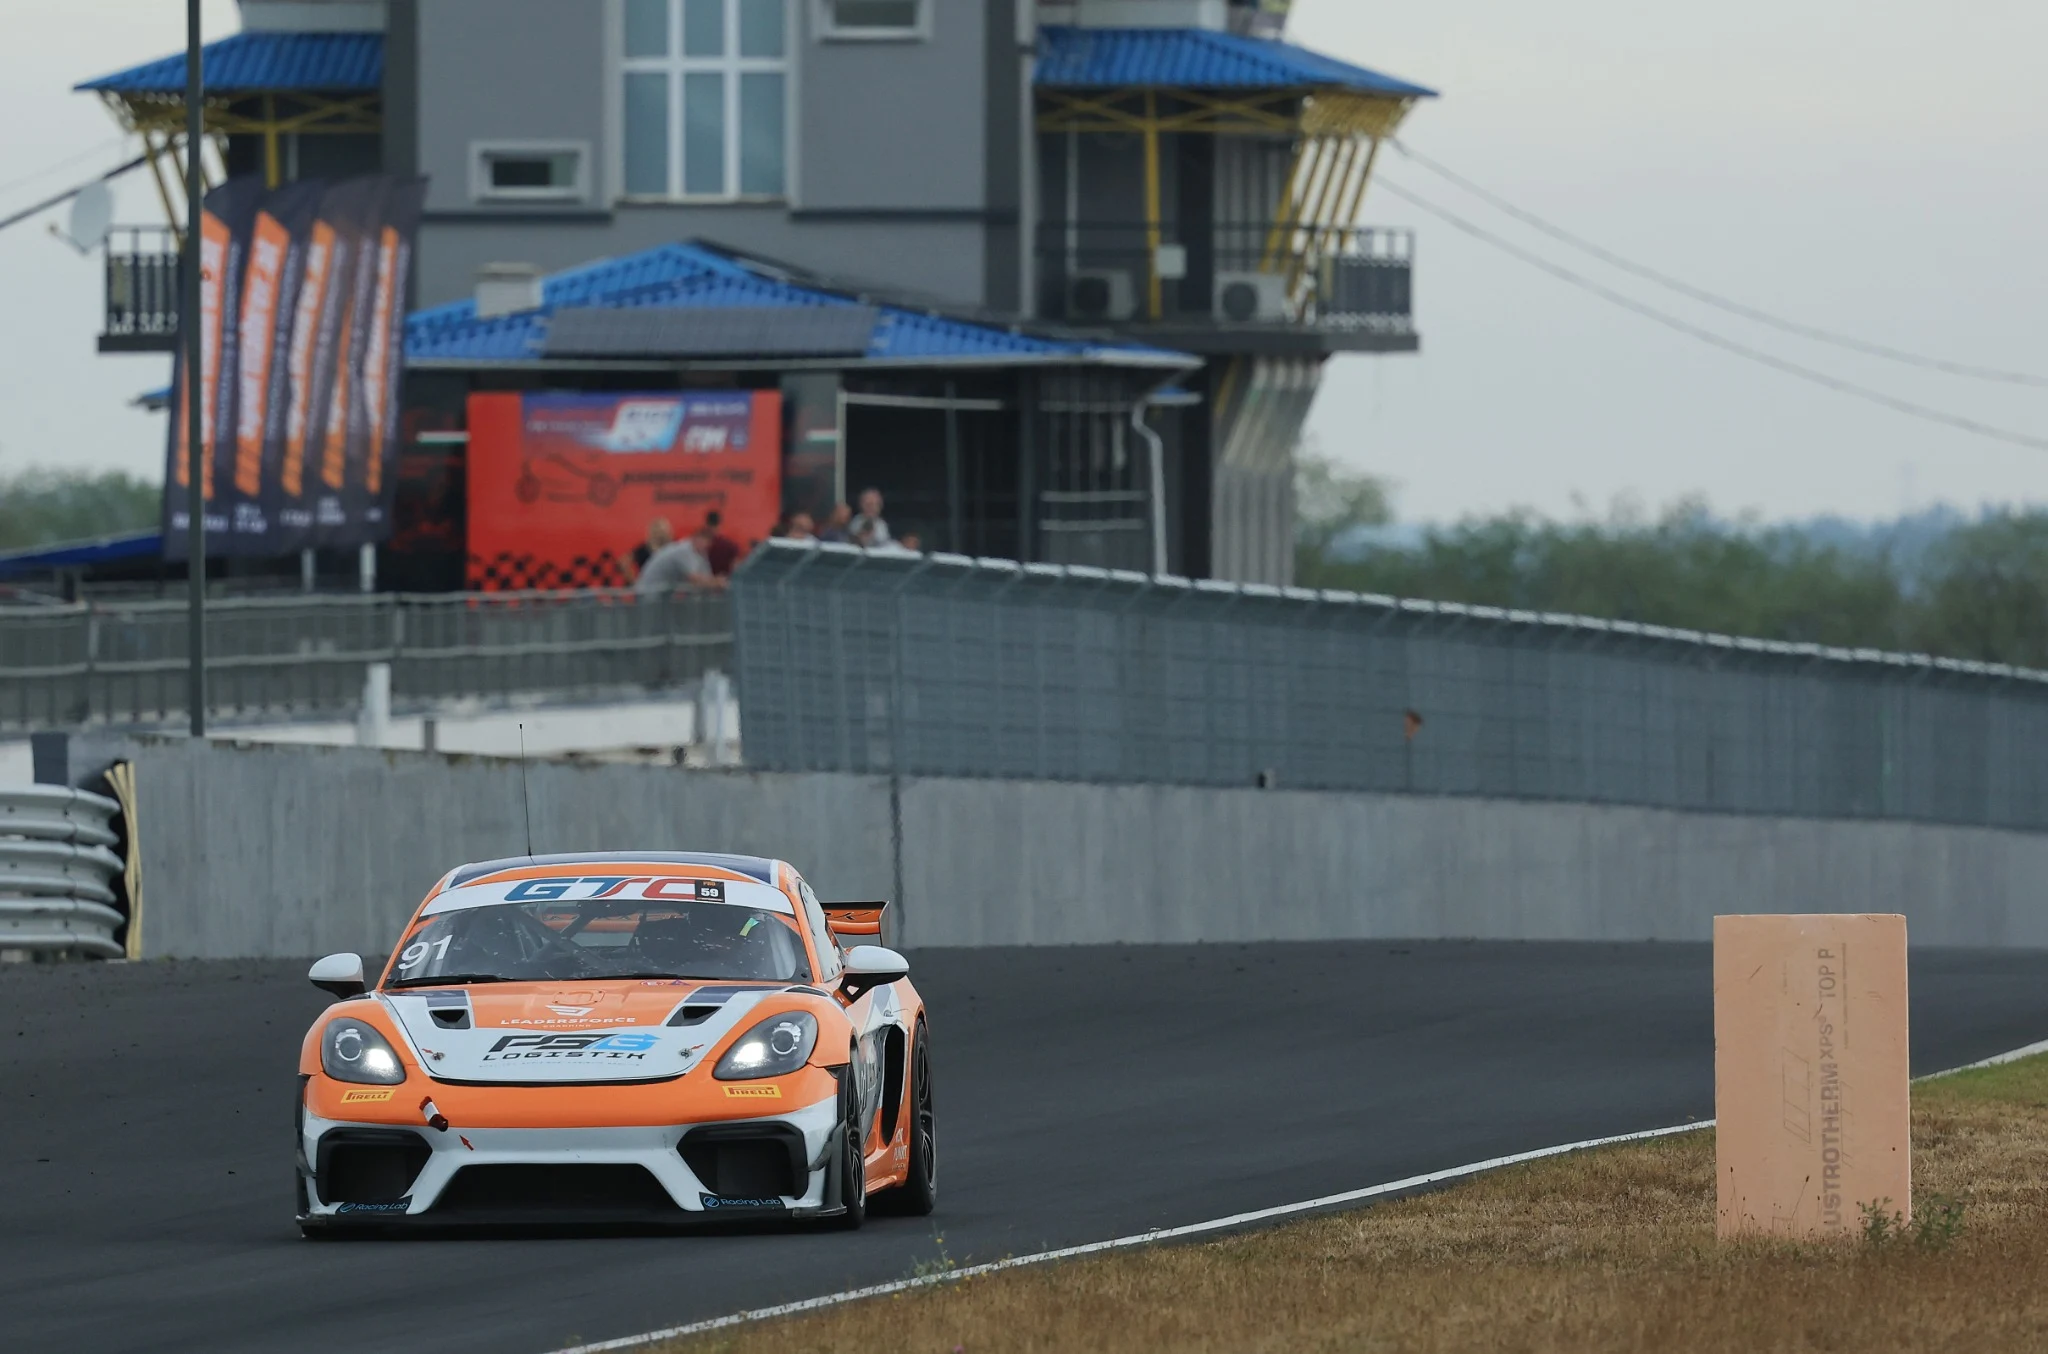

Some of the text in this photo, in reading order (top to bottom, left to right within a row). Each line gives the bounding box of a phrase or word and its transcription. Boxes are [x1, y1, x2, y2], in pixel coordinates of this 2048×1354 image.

[701, 887, 719, 897] 59
[398, 934, 453, 970] 91
[1818, 964, 1836, 999] TOP
[500, 1016, 636, 1026] LEADERSFORCE
[482, 1050, 648, 1062] LOGISTIK
[345, 1090, 390, 1101] PIRELLI
[726, 1086, 776, 1096] PIRELLI
[355, 1202, 408, 1212] Racing Lab
[719, 1197, 760, 1207] Racing
